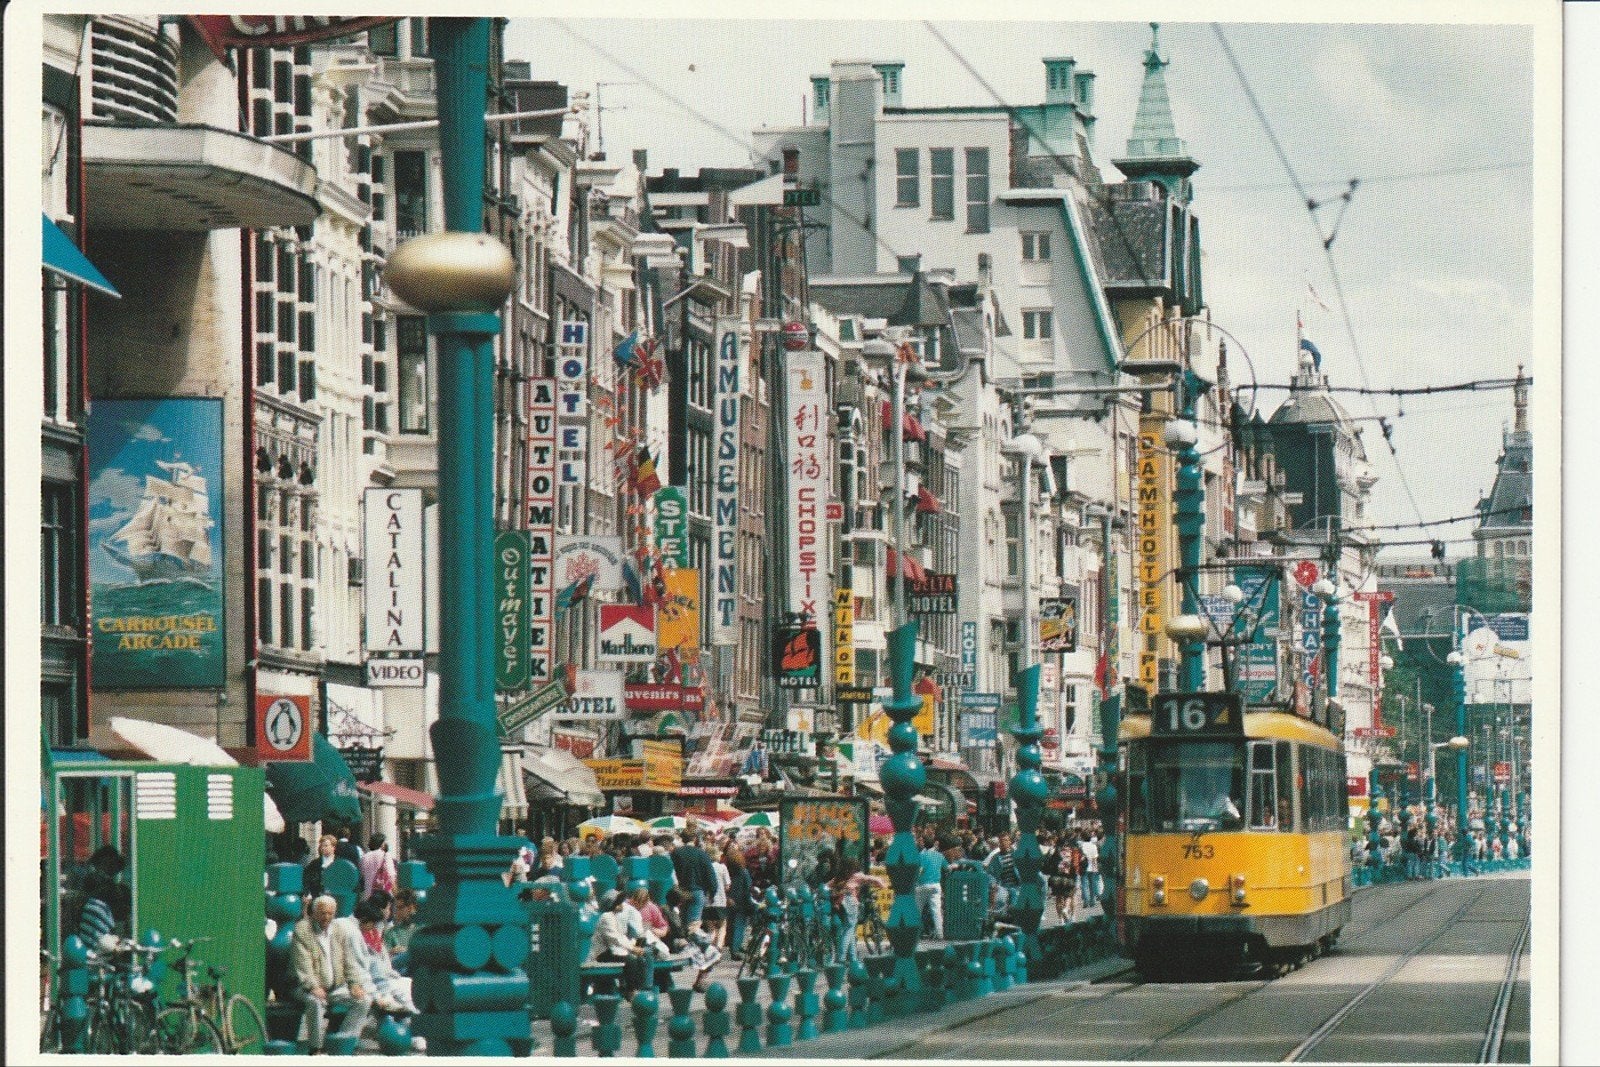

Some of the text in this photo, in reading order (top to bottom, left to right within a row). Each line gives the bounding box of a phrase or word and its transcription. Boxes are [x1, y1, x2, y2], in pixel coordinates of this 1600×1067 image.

[562, 324, 584, 482] HOTEL
[716, 331, 740, 627] AMUSEMENT
[529, 384, 553, 682] AUTOMATIEK
[798, 487, 817, 615] CHOPSTIX
[386, 492, 403, 647] CATALINA
[98, 614, 218, 633] CARROUSEL
[838, 591, 851, 681] Nikon
[117, 633, 203, 651] ARCADE
[600, 633, 655, 656] Marlboro
[369, 664, 422, 681] VIDEO
[780, 676, 818, 687] HOTEL
[1161, 700, 1206, 731] 16
[1181, 844, 1215, 859] 753
